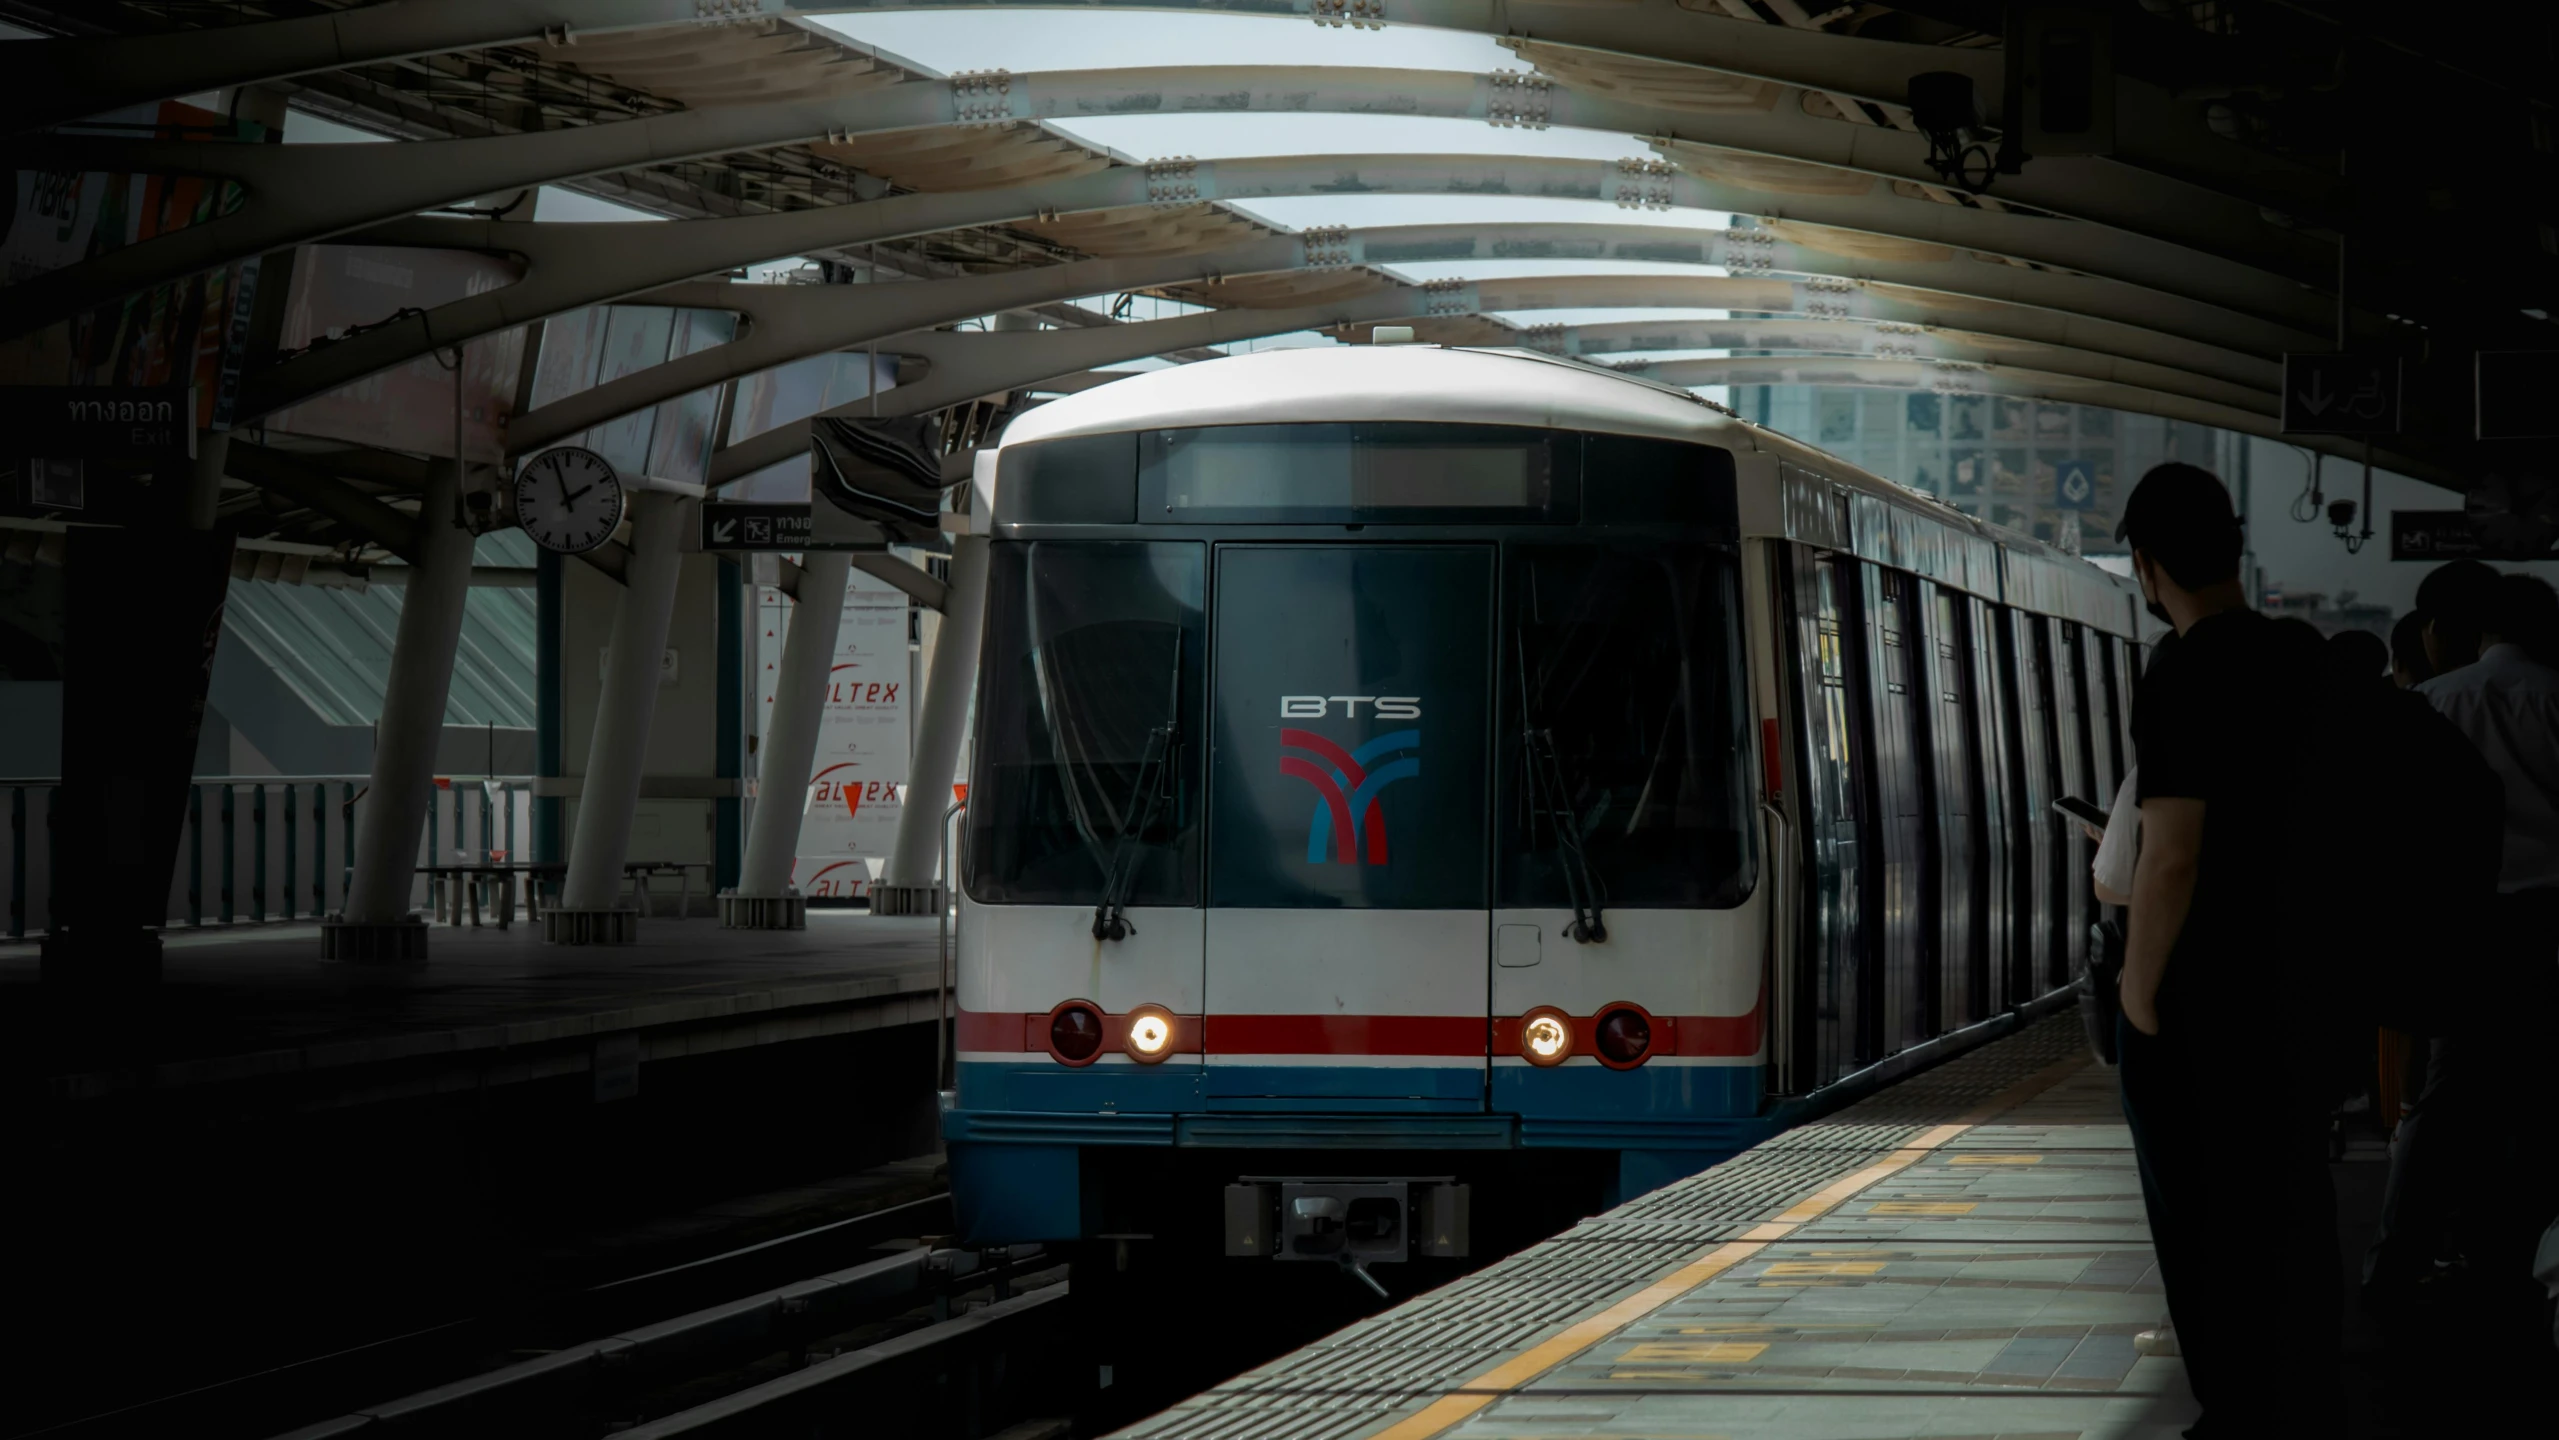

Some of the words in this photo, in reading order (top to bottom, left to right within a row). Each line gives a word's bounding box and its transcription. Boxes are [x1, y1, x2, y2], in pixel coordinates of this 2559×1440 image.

[67, 400, 173, 423] ทางออก
[131, 428, 173, 446] Exit
[1281, 695, 1421, 719] BTS
